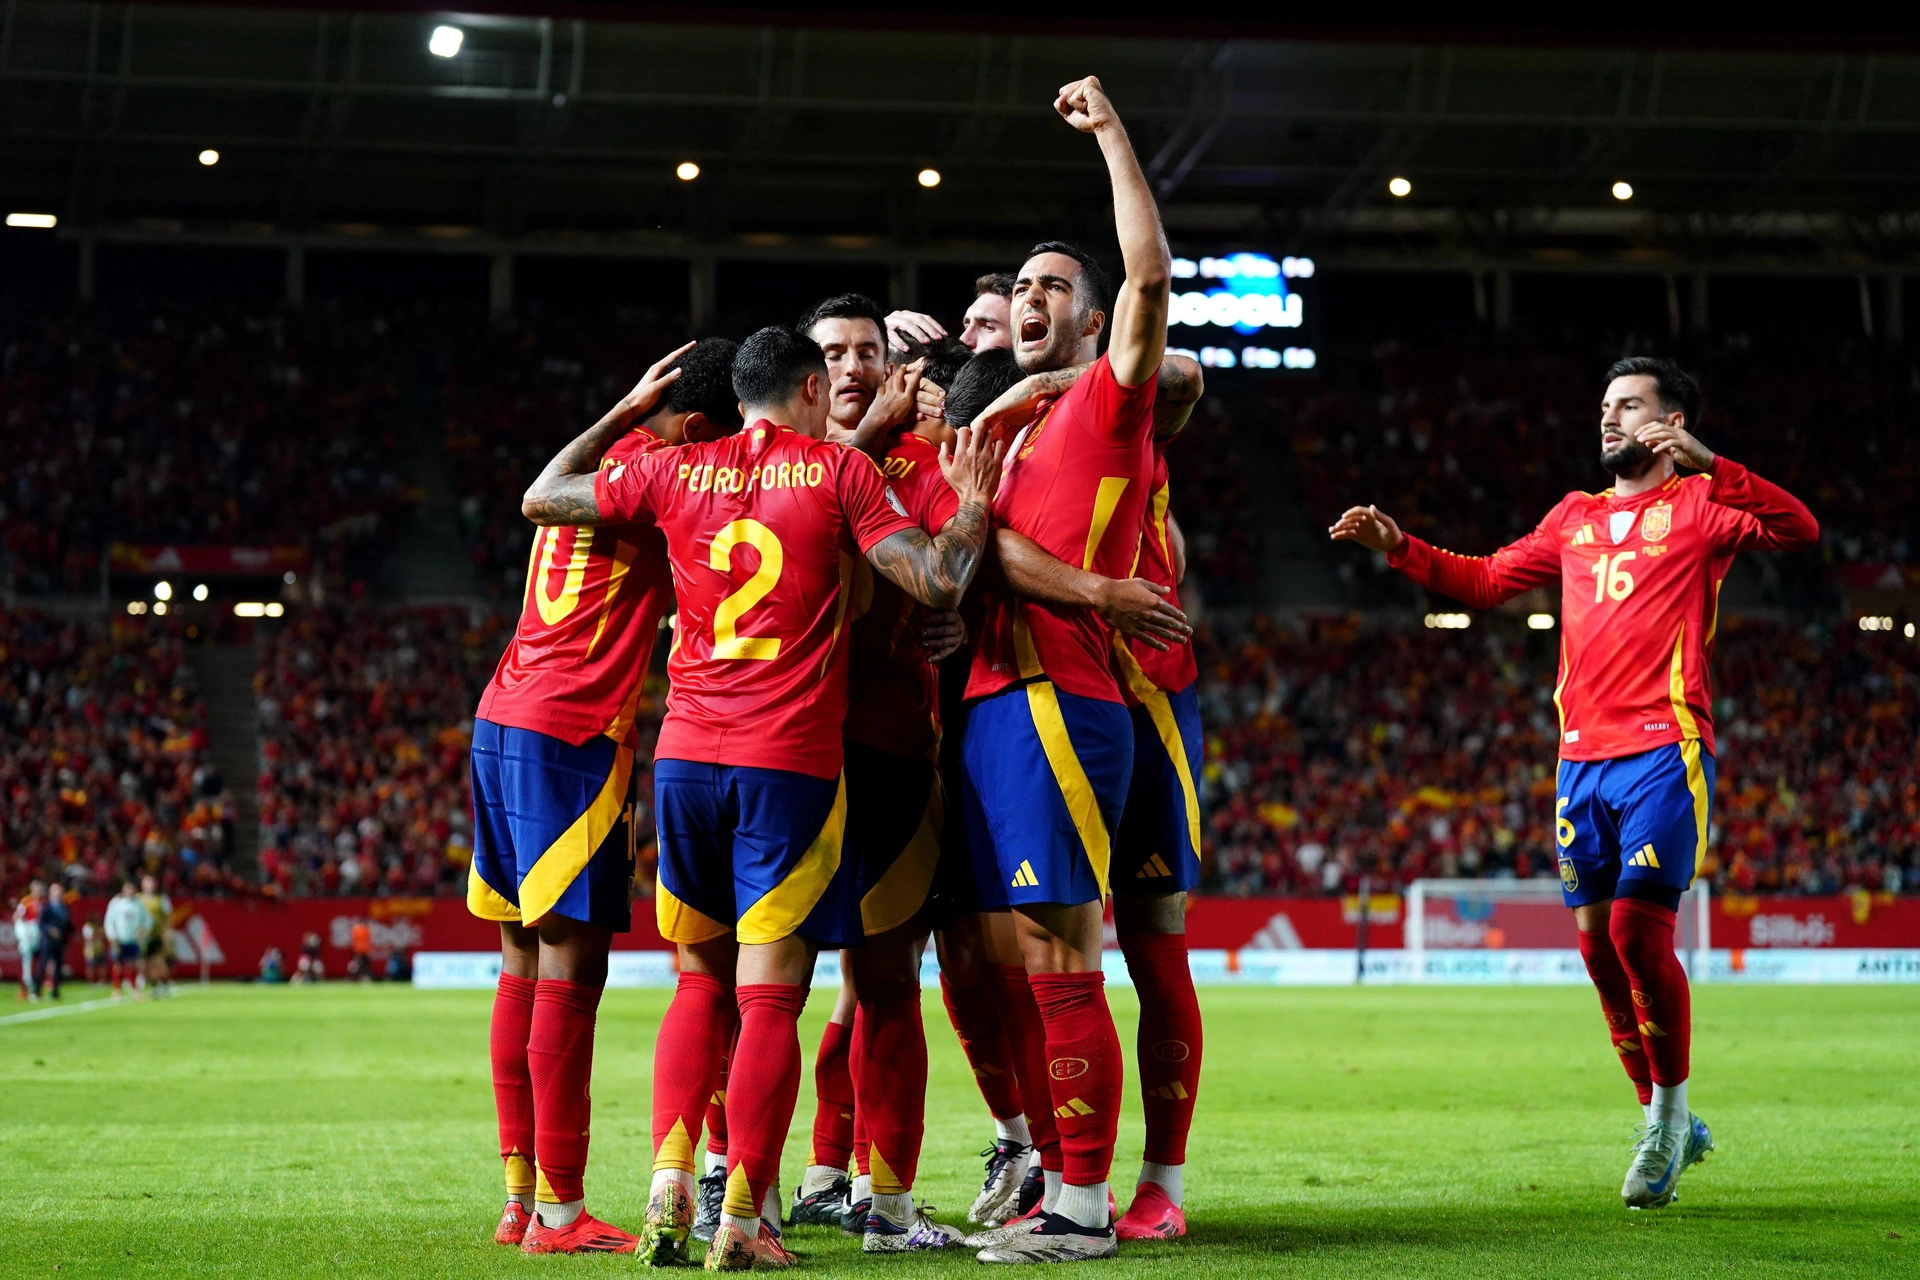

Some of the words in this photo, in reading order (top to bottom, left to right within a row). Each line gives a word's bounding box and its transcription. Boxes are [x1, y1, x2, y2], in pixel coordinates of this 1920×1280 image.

[677, 463, 746, 494] PEDRO
[747, 461, 826, 493] PORRO
[709, 518, 784, 660] 2
[1591, 550, 1636, 604] 16
